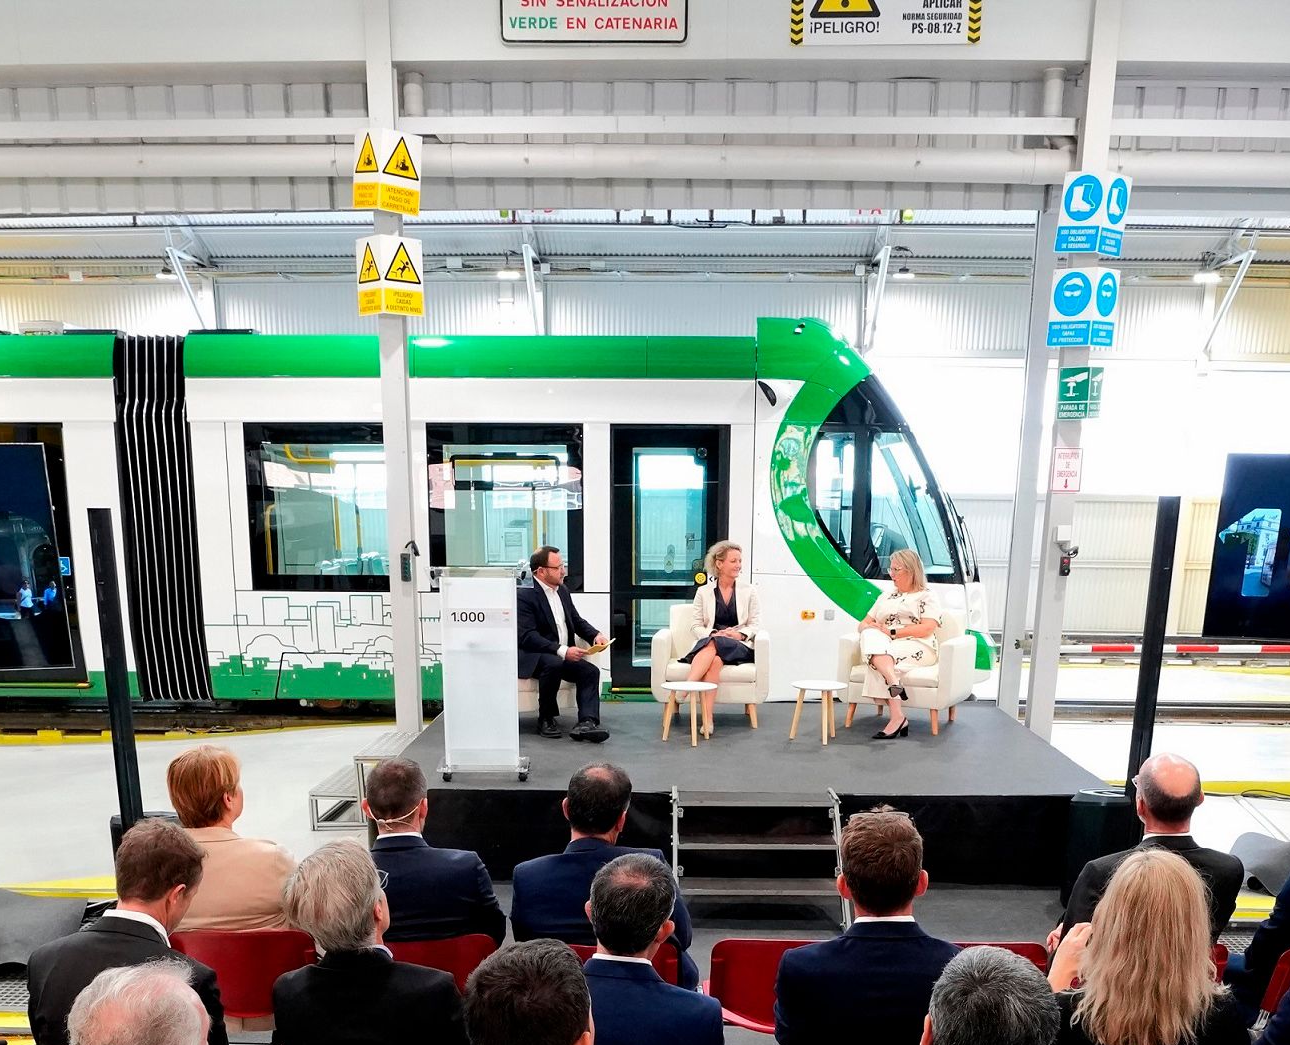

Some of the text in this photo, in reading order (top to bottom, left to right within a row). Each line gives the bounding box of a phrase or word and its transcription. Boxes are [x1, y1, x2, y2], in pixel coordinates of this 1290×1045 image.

[922, 0, 962, 9] APLICAR
[509, 16, 679, 30] VERDE EN CATENARIA
[902, 13, 963, 21] NORMA SEGURIDAD
[810, 21, 880, 34] ¡PELIGRO!
[911, 22, 961, 34] PS-08.12-Z
[450, 611, 486, 623] 1.000
